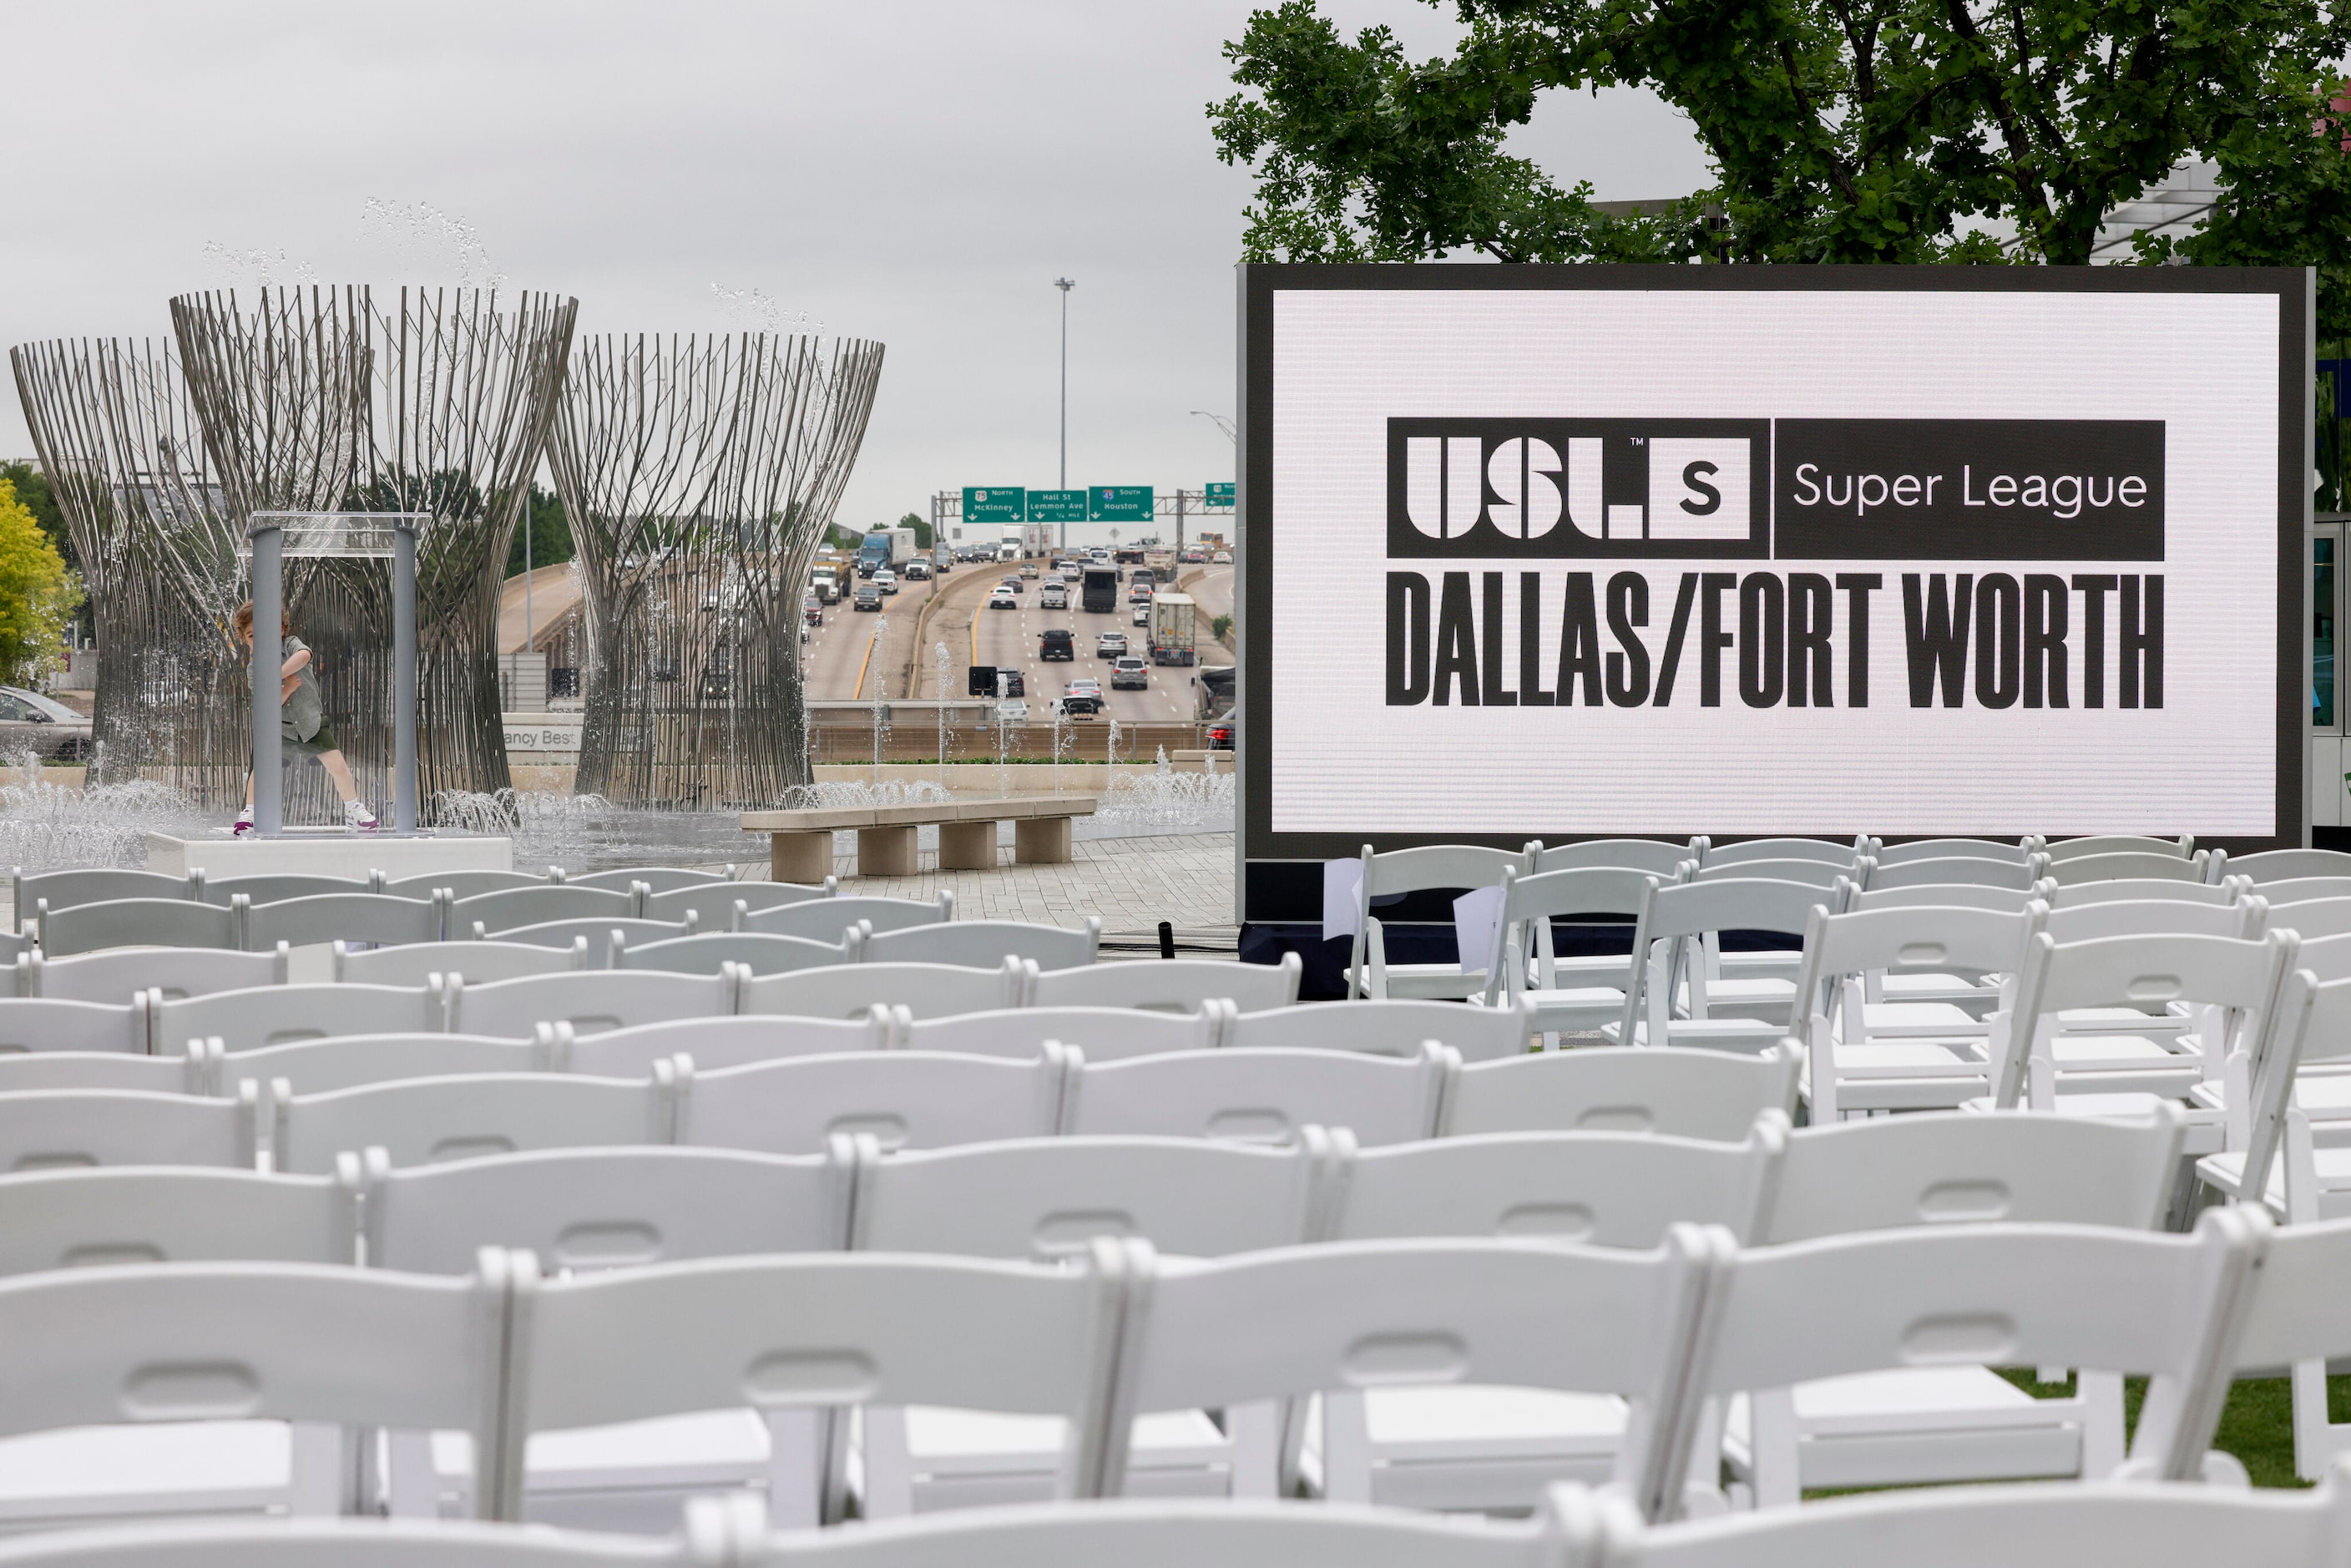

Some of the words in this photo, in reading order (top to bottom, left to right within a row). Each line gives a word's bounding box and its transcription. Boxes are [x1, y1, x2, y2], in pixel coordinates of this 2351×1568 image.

[974, 504, 1013, 513] McKinney
[1406, 437, 1643, 539] USL
[1679, 460, 1720, 516] S
[1793, 463, 1943, 516] Super
[1964, 464, 2148, 518] League
[1386, 571, 1882, 708] DALLAS/FORT
[1902, 573, 2165, 709] WORTH
[504, 733, 538, 746] ancy
